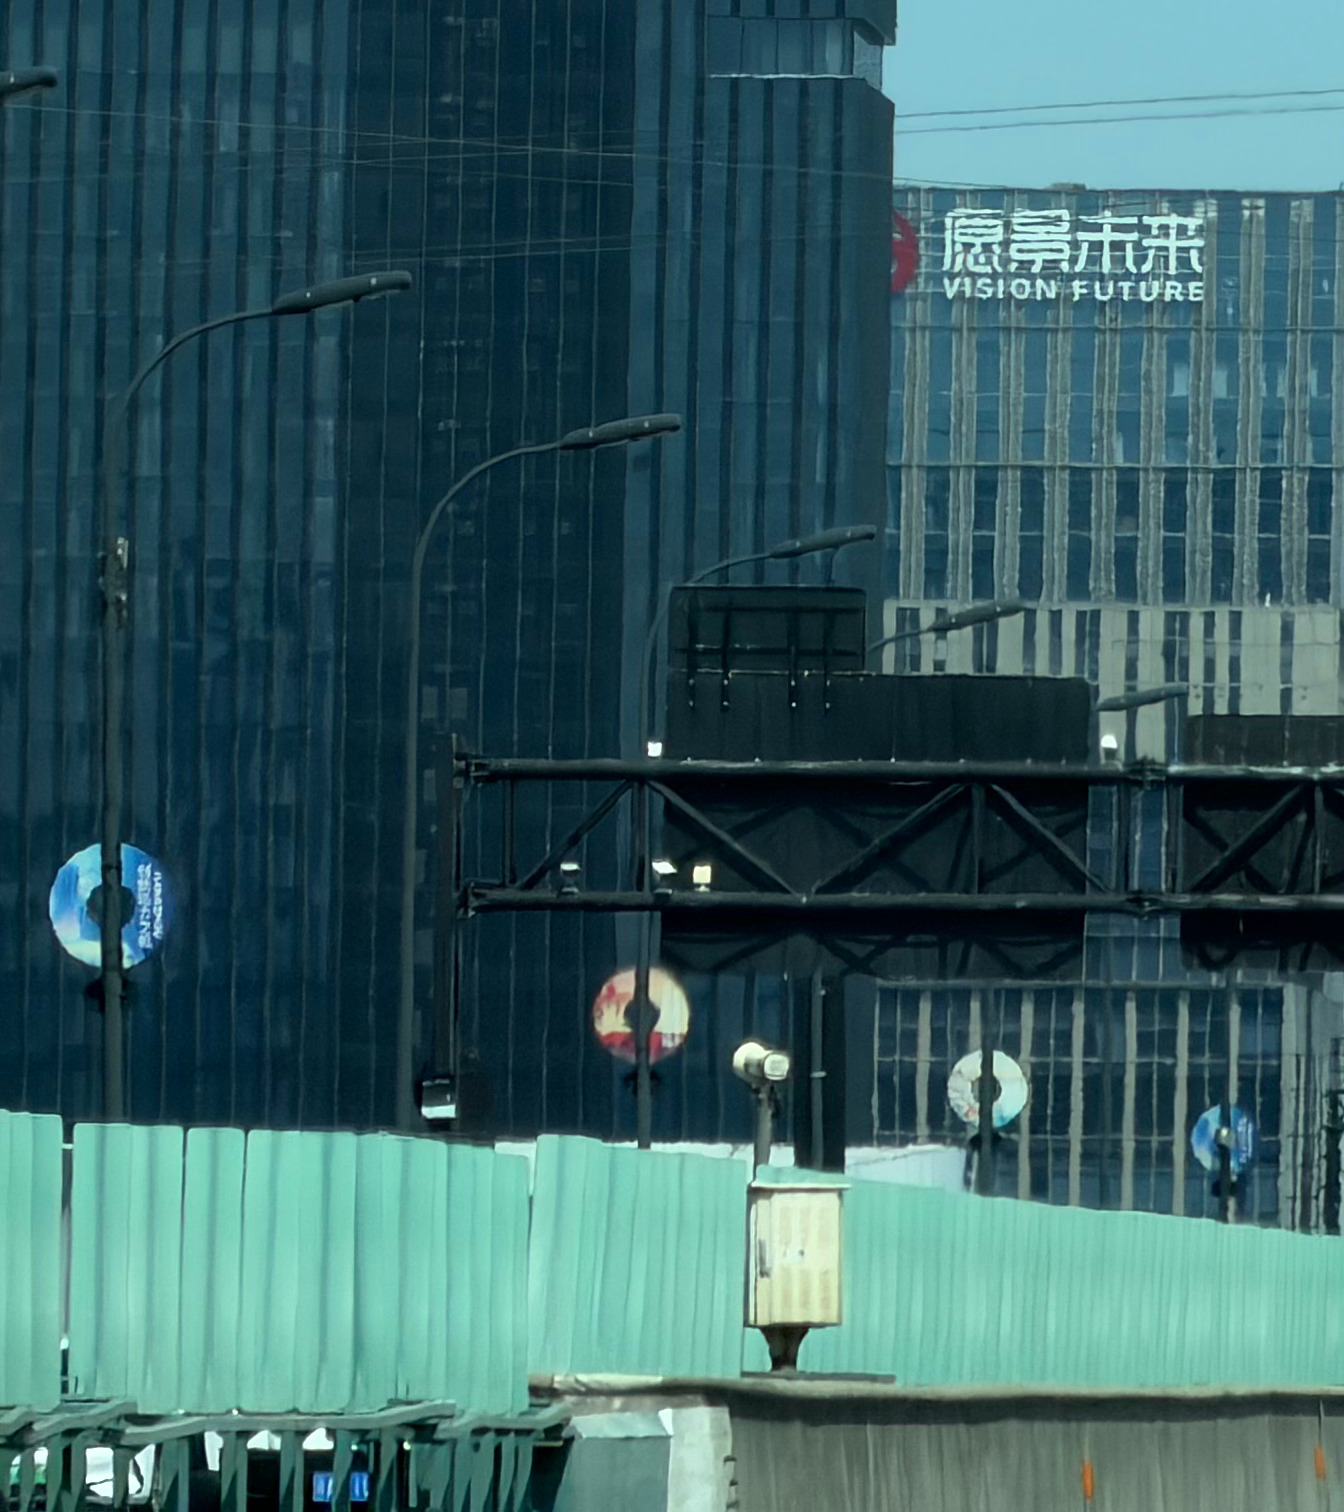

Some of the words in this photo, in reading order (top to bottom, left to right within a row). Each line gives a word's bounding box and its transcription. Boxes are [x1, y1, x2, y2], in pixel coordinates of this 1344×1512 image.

[942, 208, 1205, 275] 愿景未来
[942, 276, 1056, 300] VISION
[1072, 279, 1205, 302] FUTURE
